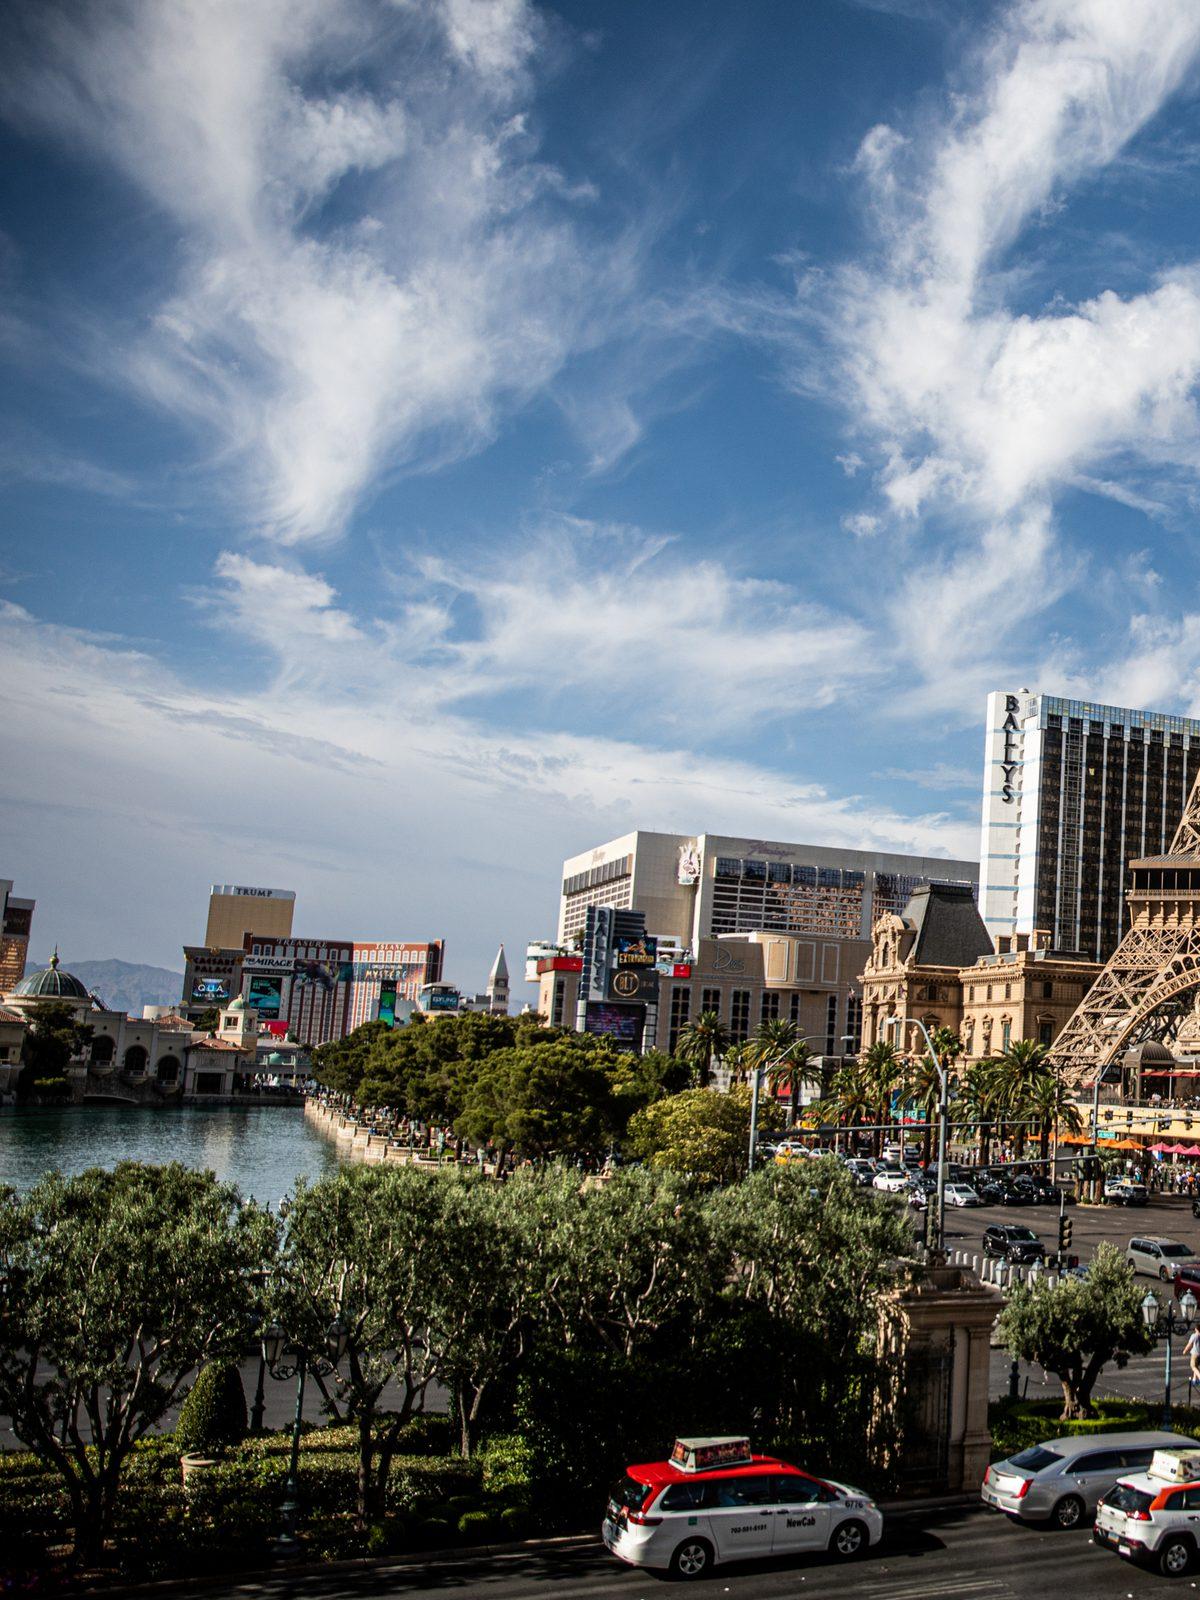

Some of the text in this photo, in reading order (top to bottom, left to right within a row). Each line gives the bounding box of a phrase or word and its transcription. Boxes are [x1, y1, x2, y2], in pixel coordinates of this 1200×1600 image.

[236, 887, 273, 898] TRUMP
[276, 938, 328, 948] TREASURE
[256, 958, 293, 967] MIRAGE
[195, 965, 233, 974] PALACE
[786, 1516, 816, 1529] NewCab
